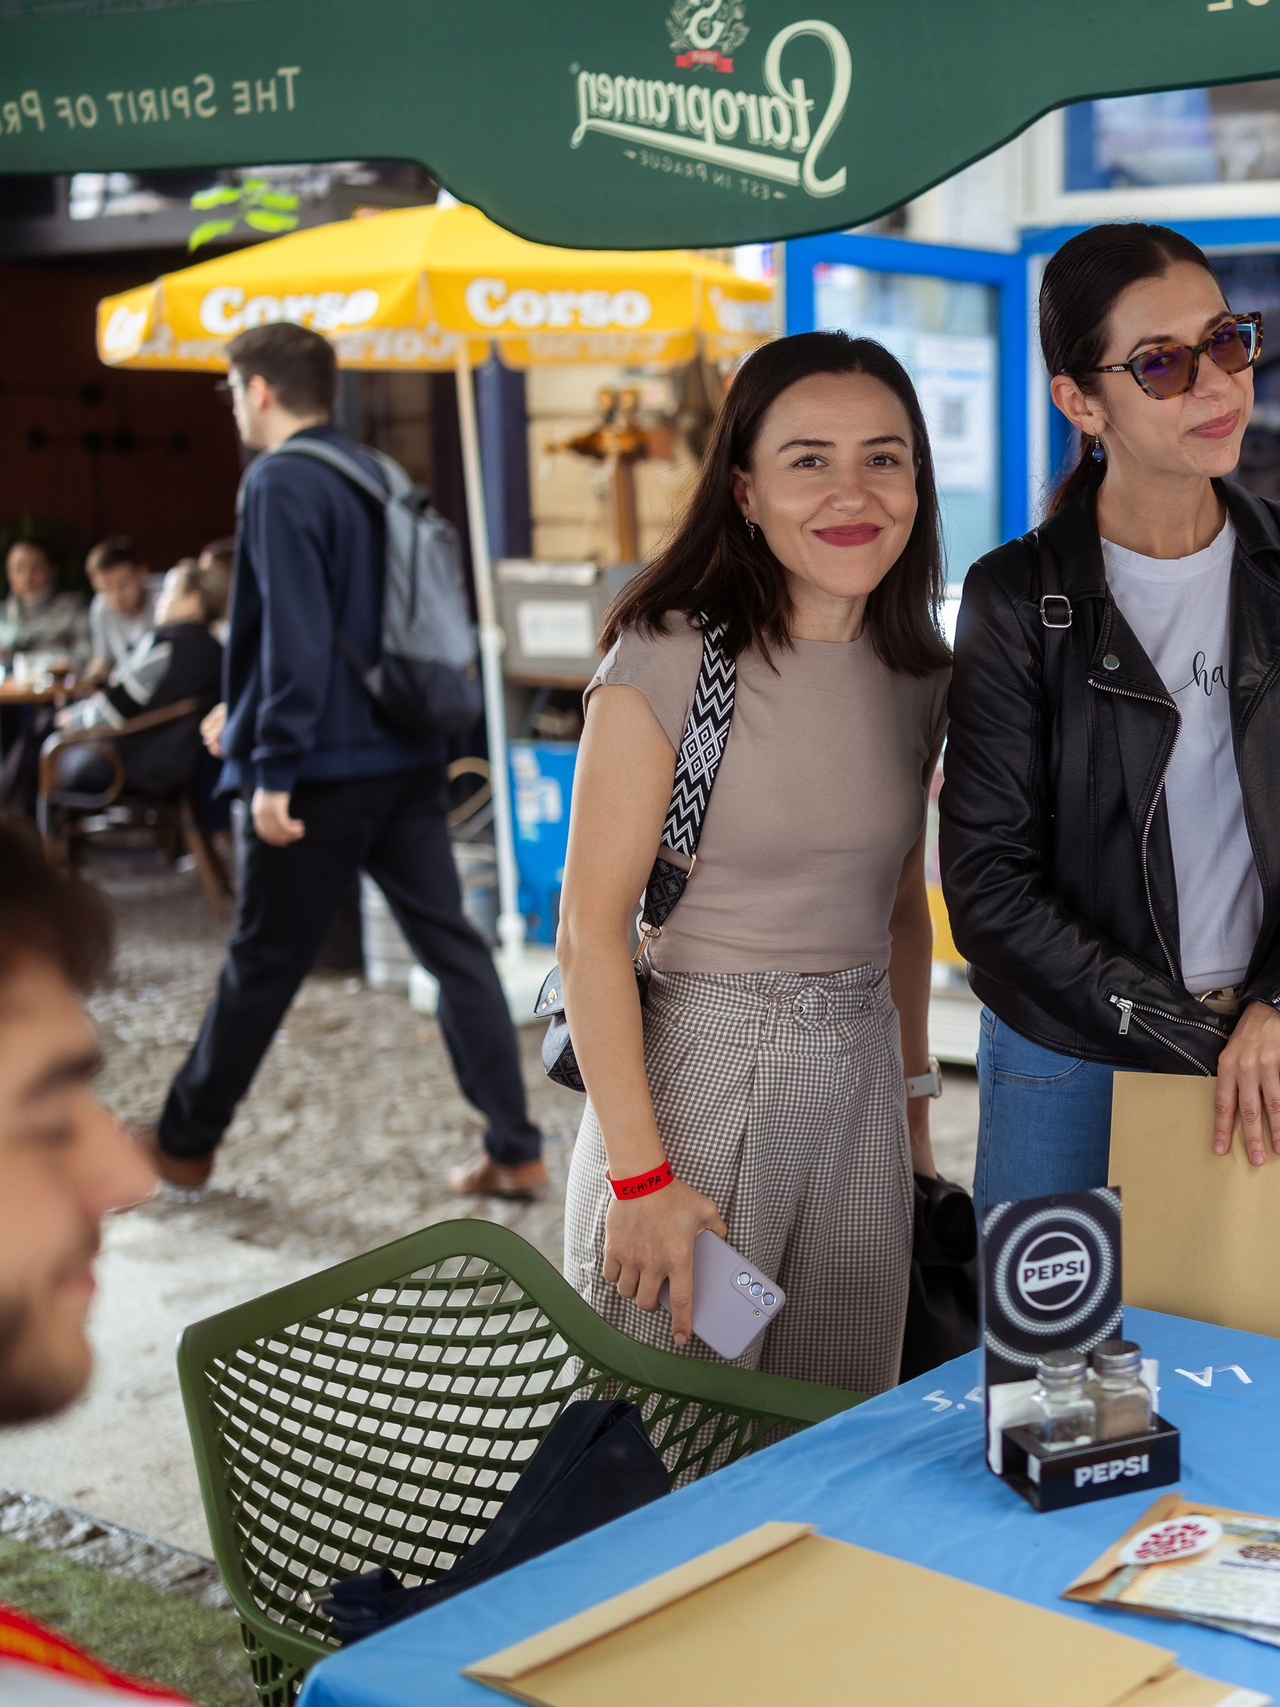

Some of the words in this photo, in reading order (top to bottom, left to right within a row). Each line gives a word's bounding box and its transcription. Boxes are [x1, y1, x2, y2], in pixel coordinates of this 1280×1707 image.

[200, 286, 379, 335] Corso
[464, 276, 652, 329] Corso
[1022, 1259, 1085, 1283] PEPSI
[1074, 1454, 1150, 1488] PEPSI
